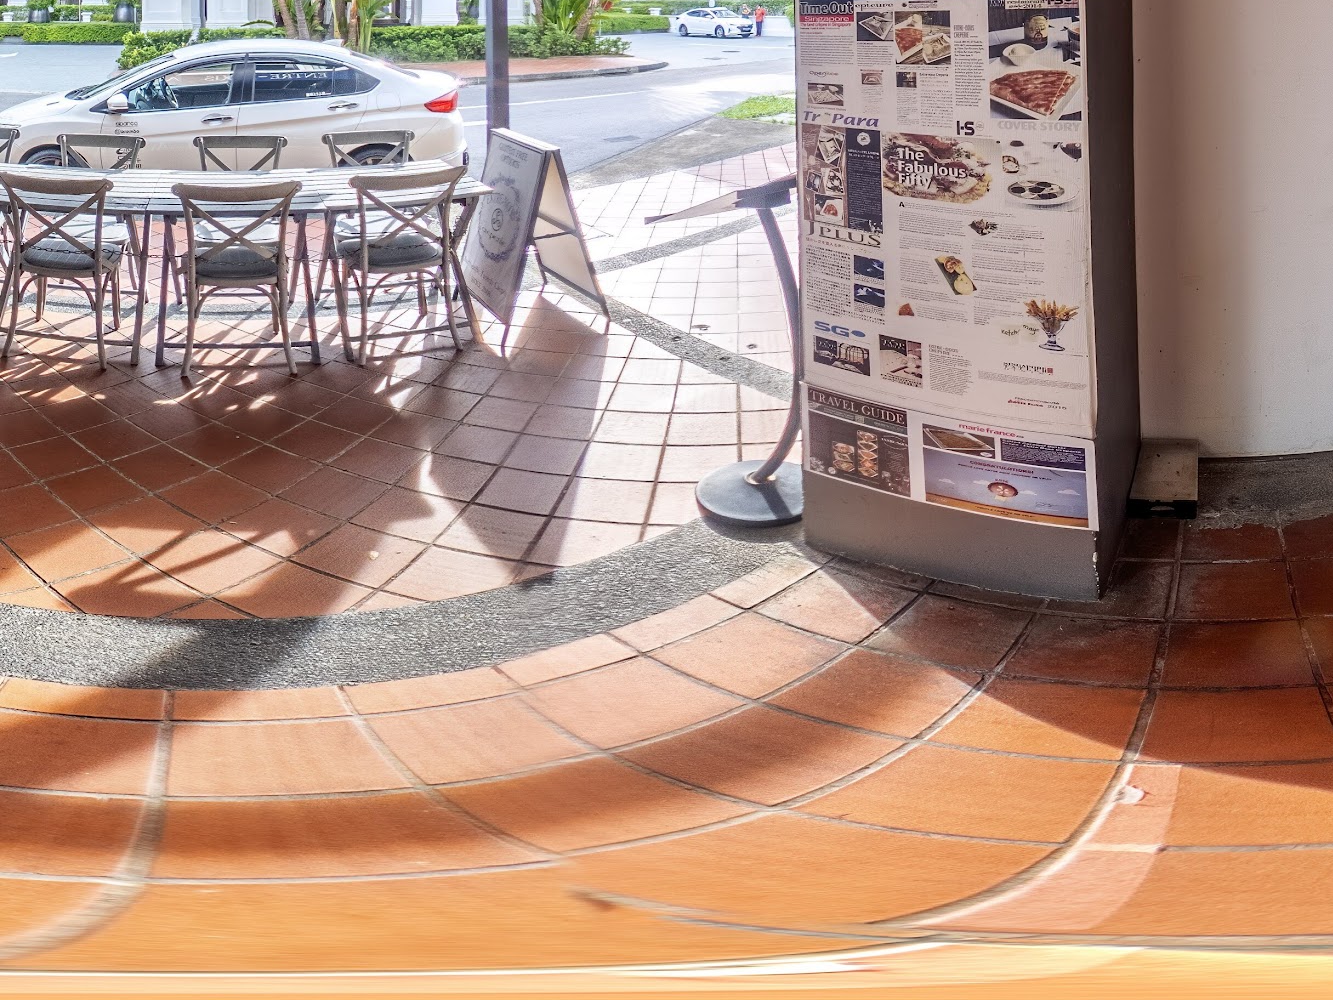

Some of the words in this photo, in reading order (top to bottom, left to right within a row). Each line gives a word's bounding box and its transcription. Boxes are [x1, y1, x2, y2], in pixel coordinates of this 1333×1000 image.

[998, 121, 1039, 131] COVER
[1040, 121, 1081, 132] STORY
[897, 148, 925, 161] The
[897, 161, 968, 178] Fabulous
[897, 172, 933, 190] Fifty
[810, 390, 859, 413] TRAVEL
[861, 404, 905, 425] GUIDE
